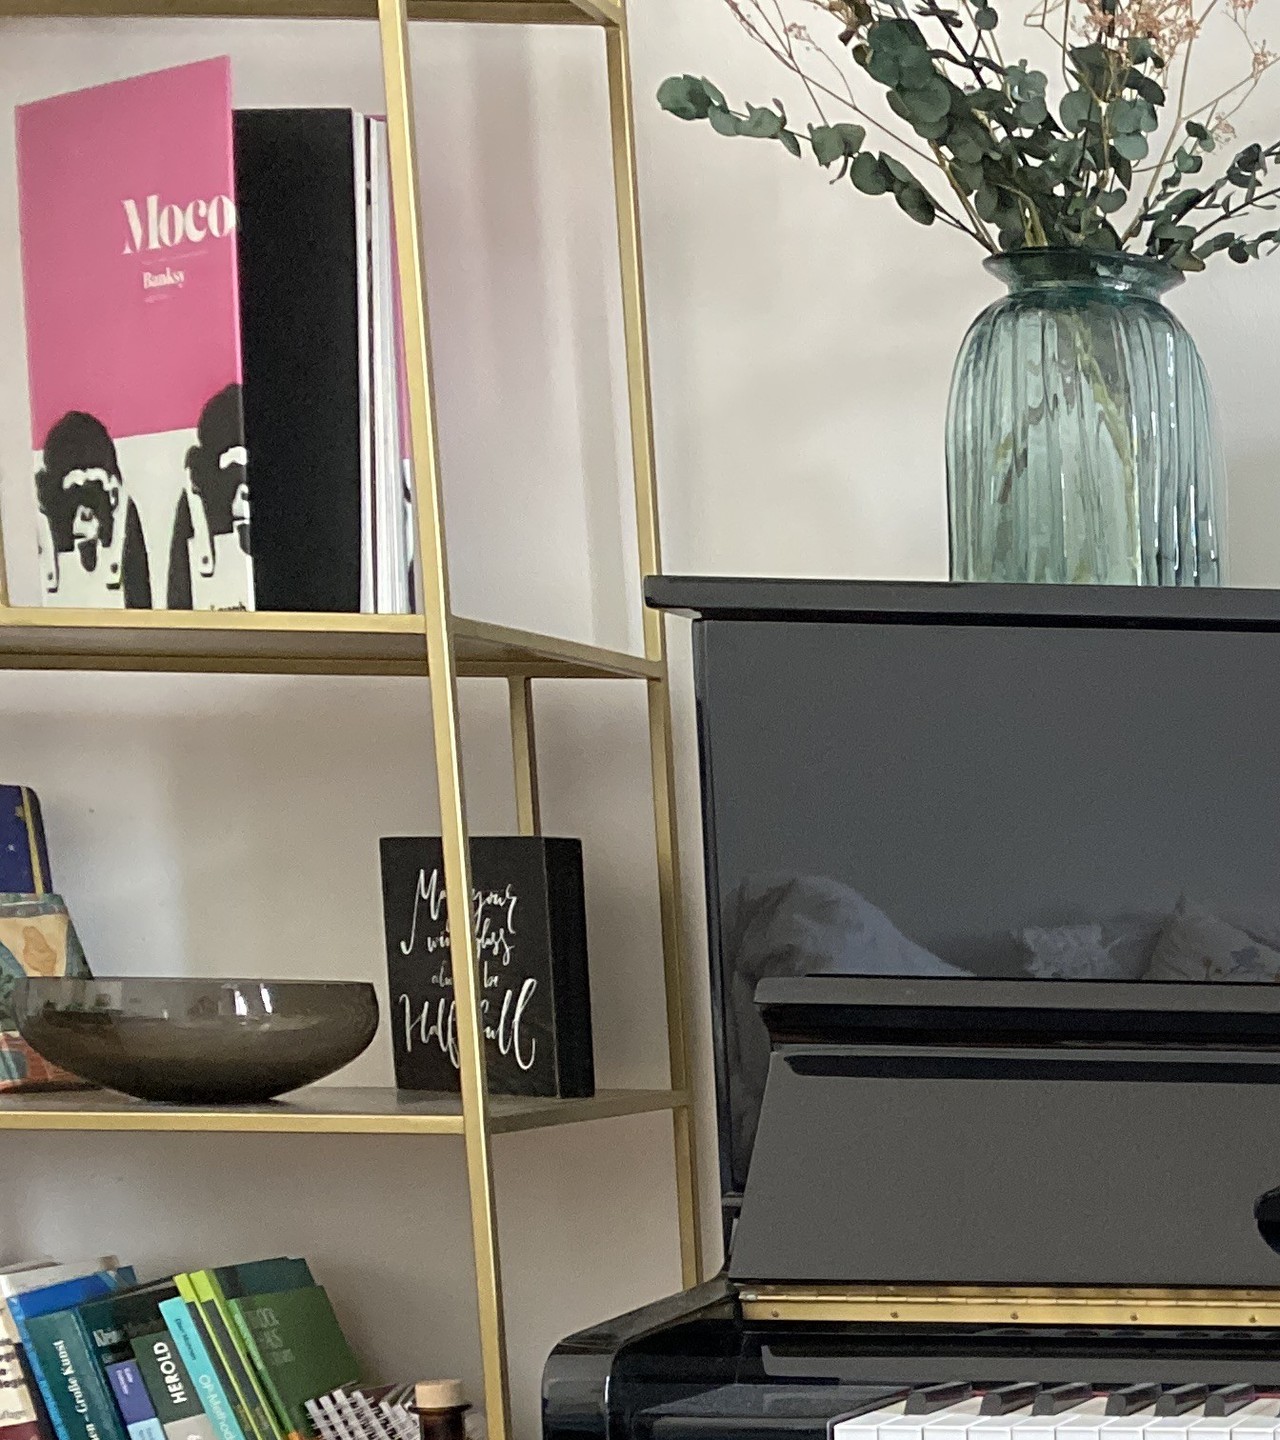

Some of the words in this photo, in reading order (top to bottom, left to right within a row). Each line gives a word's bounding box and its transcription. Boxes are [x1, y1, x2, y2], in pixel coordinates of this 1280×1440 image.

[121, 194, 237, 255] Moco
[142, 266, 185, 290] Banksy
[153, 1341, 188, 1404] HEROLD
